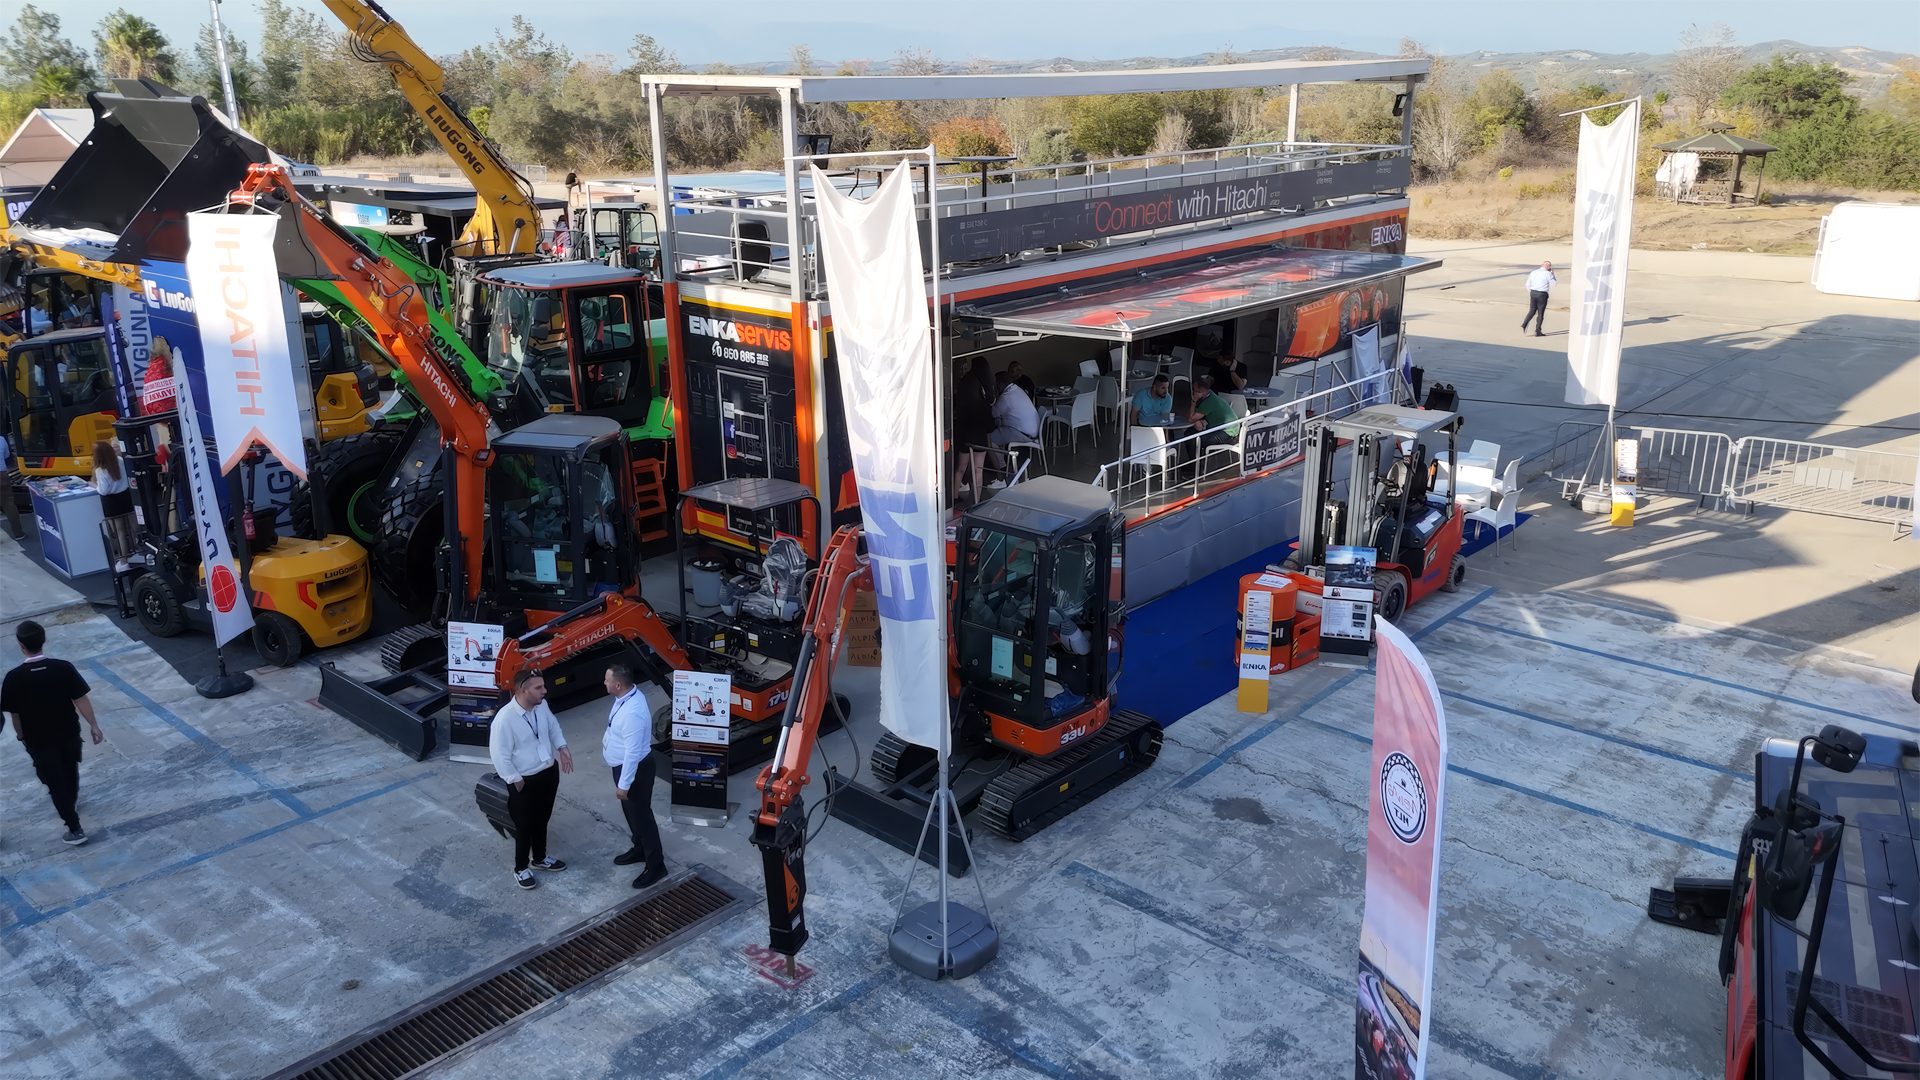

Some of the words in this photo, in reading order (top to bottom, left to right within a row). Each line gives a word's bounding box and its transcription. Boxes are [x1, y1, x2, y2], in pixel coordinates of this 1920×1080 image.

[425, 104, 486, 175] LIUGONG
[1095, 195, 1173, 233] Connect
[1178, 188, 1210, 220] with
[1215, 179, 1269, 215] Hitachi
[1371, 223, 1402, 247] ENKA
[159, 288, 197, 314] LIUGO
[129, 291, 150, 391] UYGUNLA
[716, 345, 723, 357] 0
[723, 347, 739, 360] 850
[740, 350, 756, 364] 885
[420, 356, 457, 408] HITACHI
[1246, 431, 1266, 449] MY
[1268, 419, 1299, 444] HITACHI
[1245, 436, 1297, 466] EXPERIENCE
[1060, 724, 1086, 745] 33U
